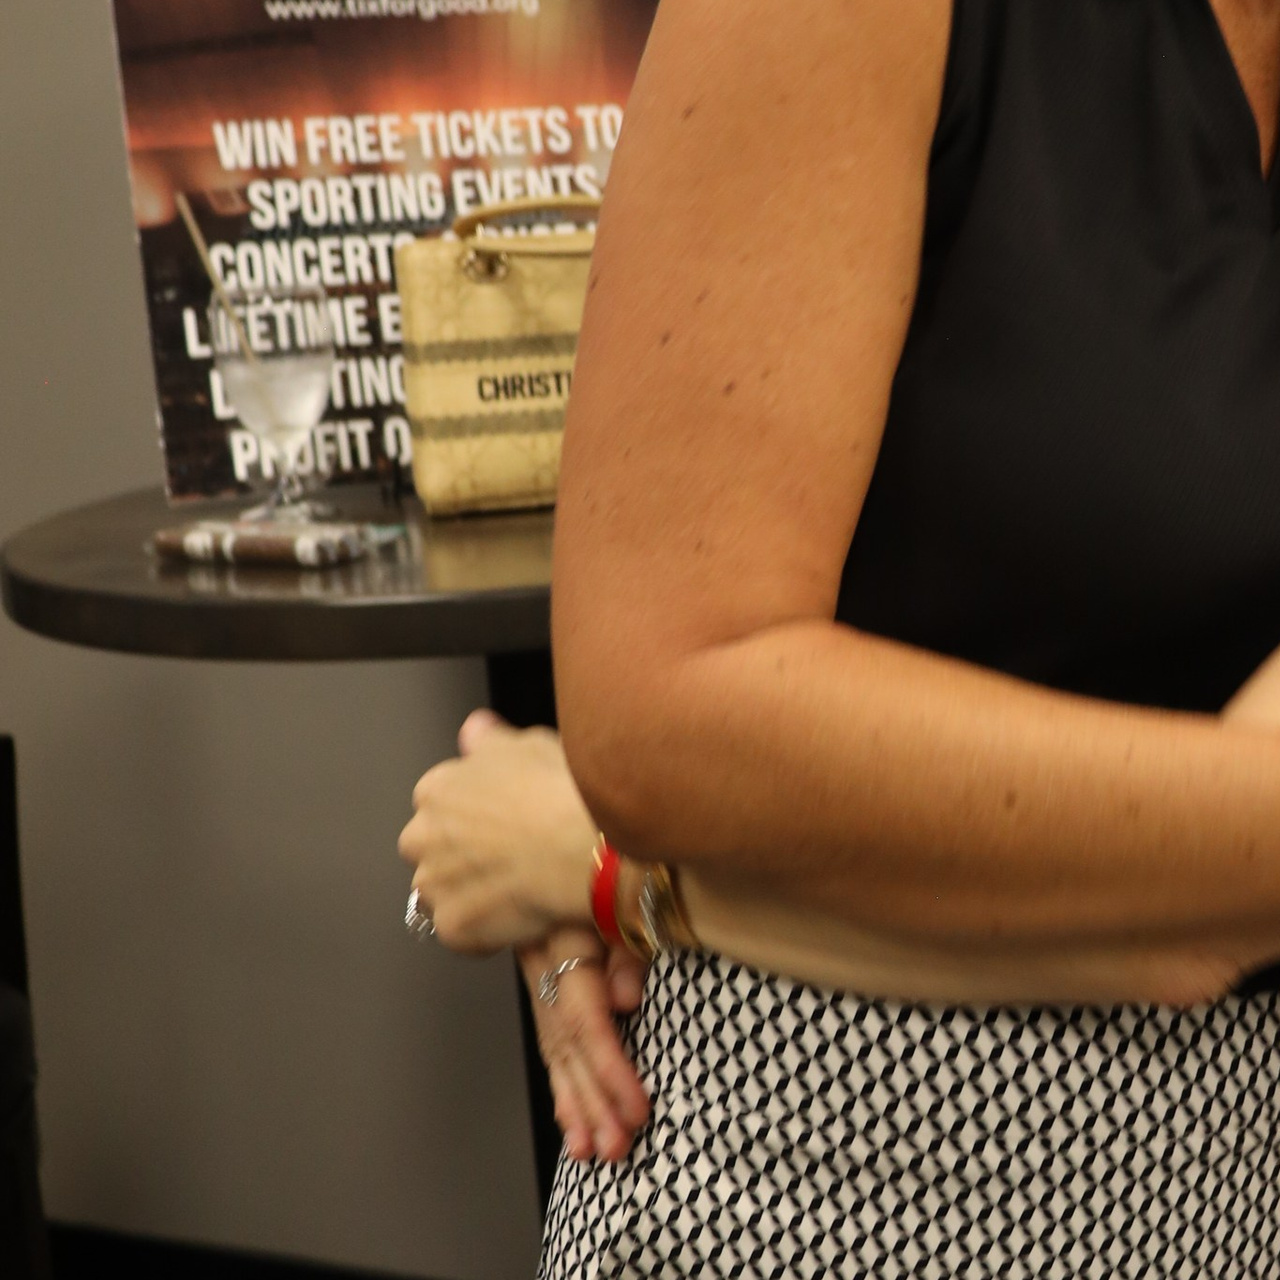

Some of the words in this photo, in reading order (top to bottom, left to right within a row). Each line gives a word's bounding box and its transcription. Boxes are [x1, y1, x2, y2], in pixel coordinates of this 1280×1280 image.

[212, 117, 297, 171] WIN
[304, 113, 406, 166] FREE
[412, 105, 573, 160] TICKETS
[576, 103, 625, 151] TO
[247, 172, 445, 230] SPORTING
[208, 232, 416, 292] CONCERT
